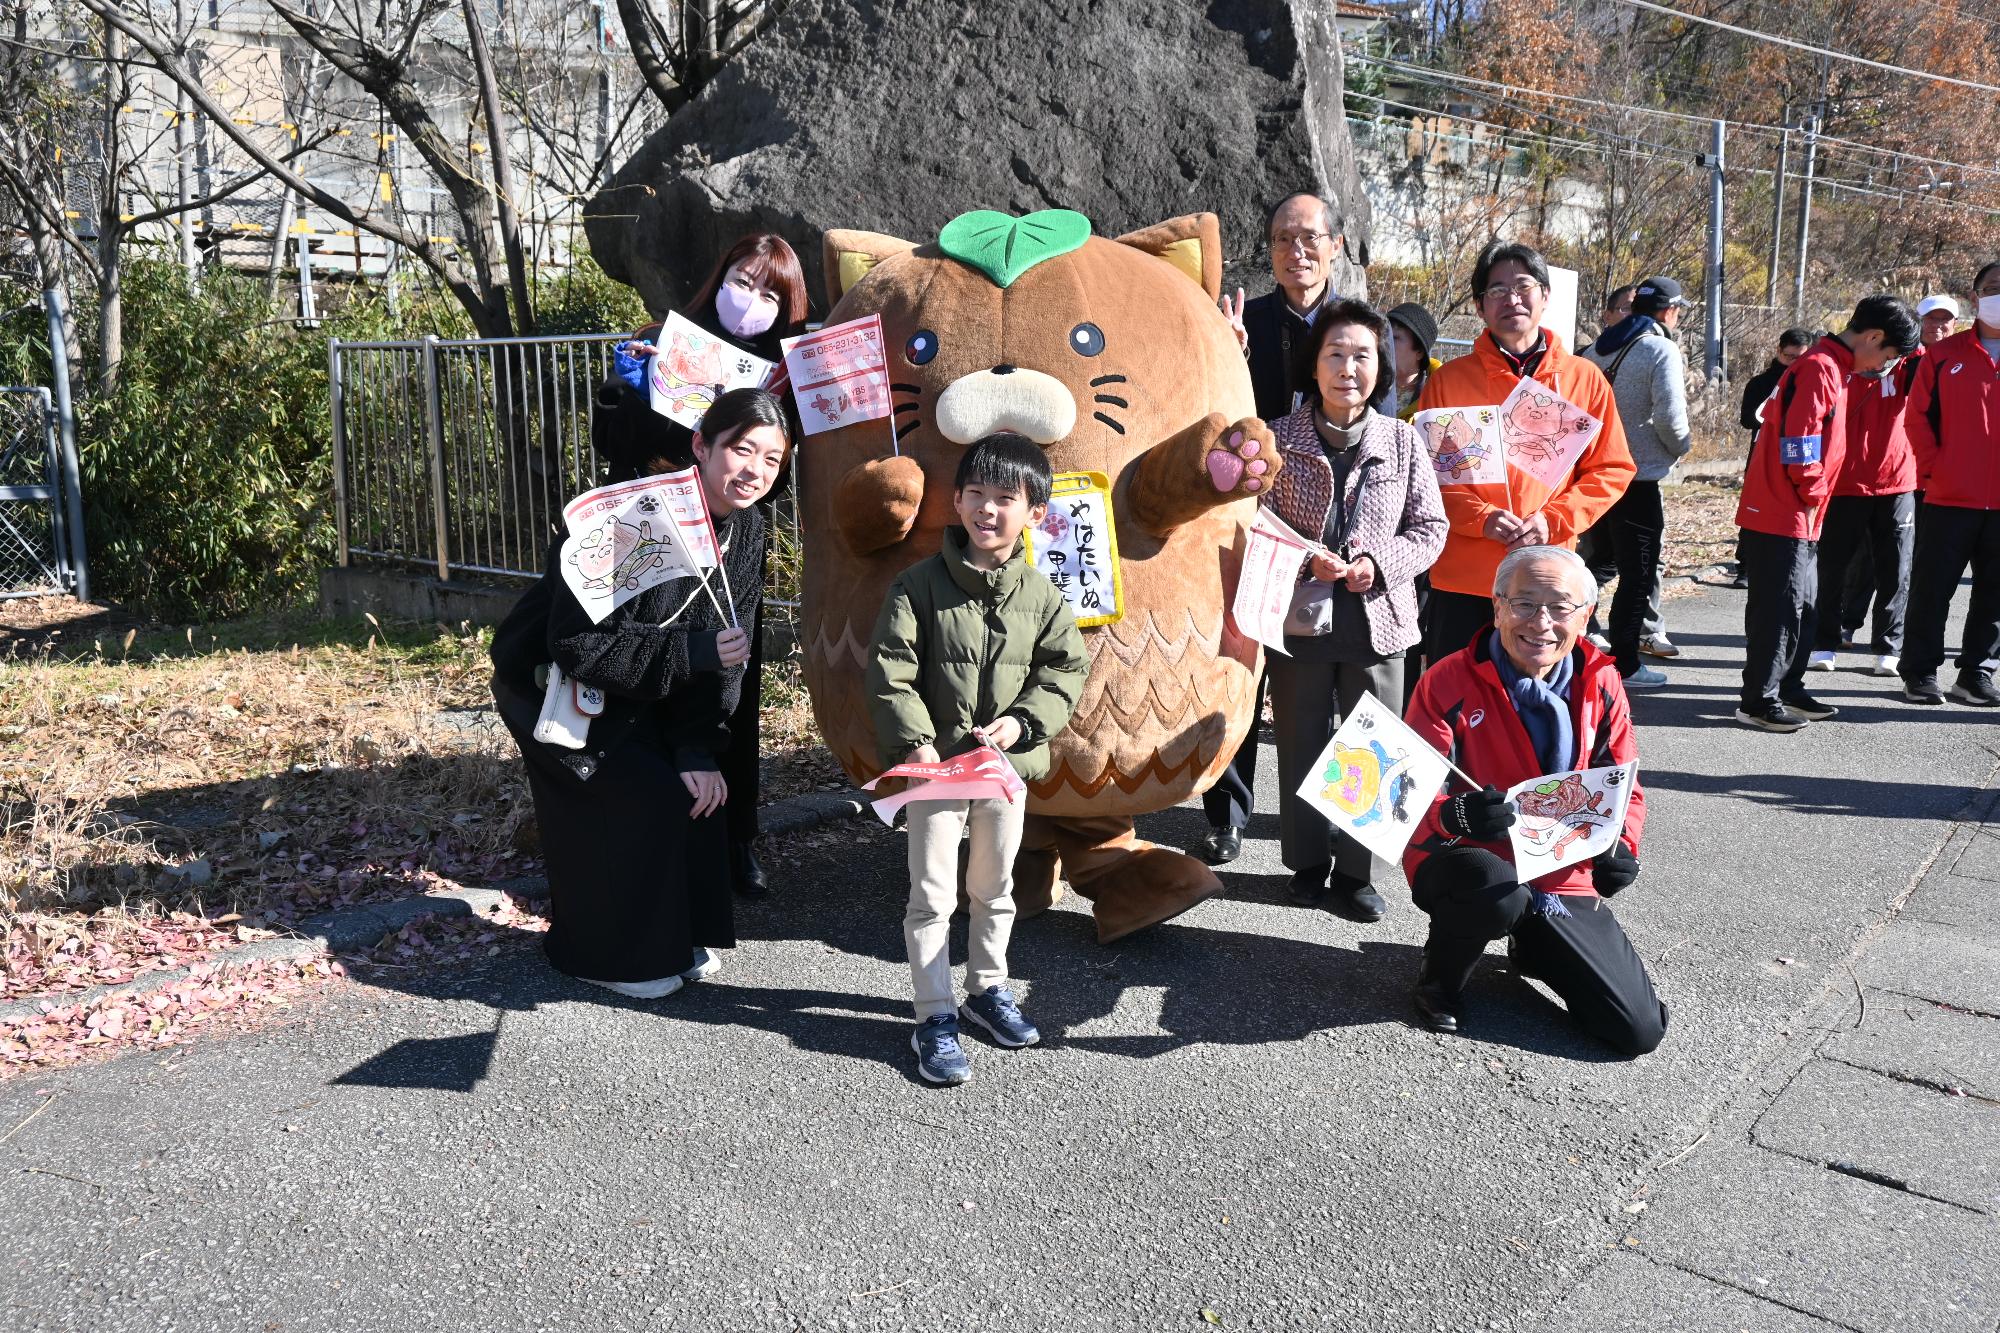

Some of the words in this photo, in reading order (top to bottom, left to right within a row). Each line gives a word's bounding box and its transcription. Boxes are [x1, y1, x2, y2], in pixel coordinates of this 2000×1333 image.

[817, 331, 876, 355] 055-231-3132
[1047, 549, 1074, 603] 甲斐
[1070, 499, 1102, 609] やはたいぬ
